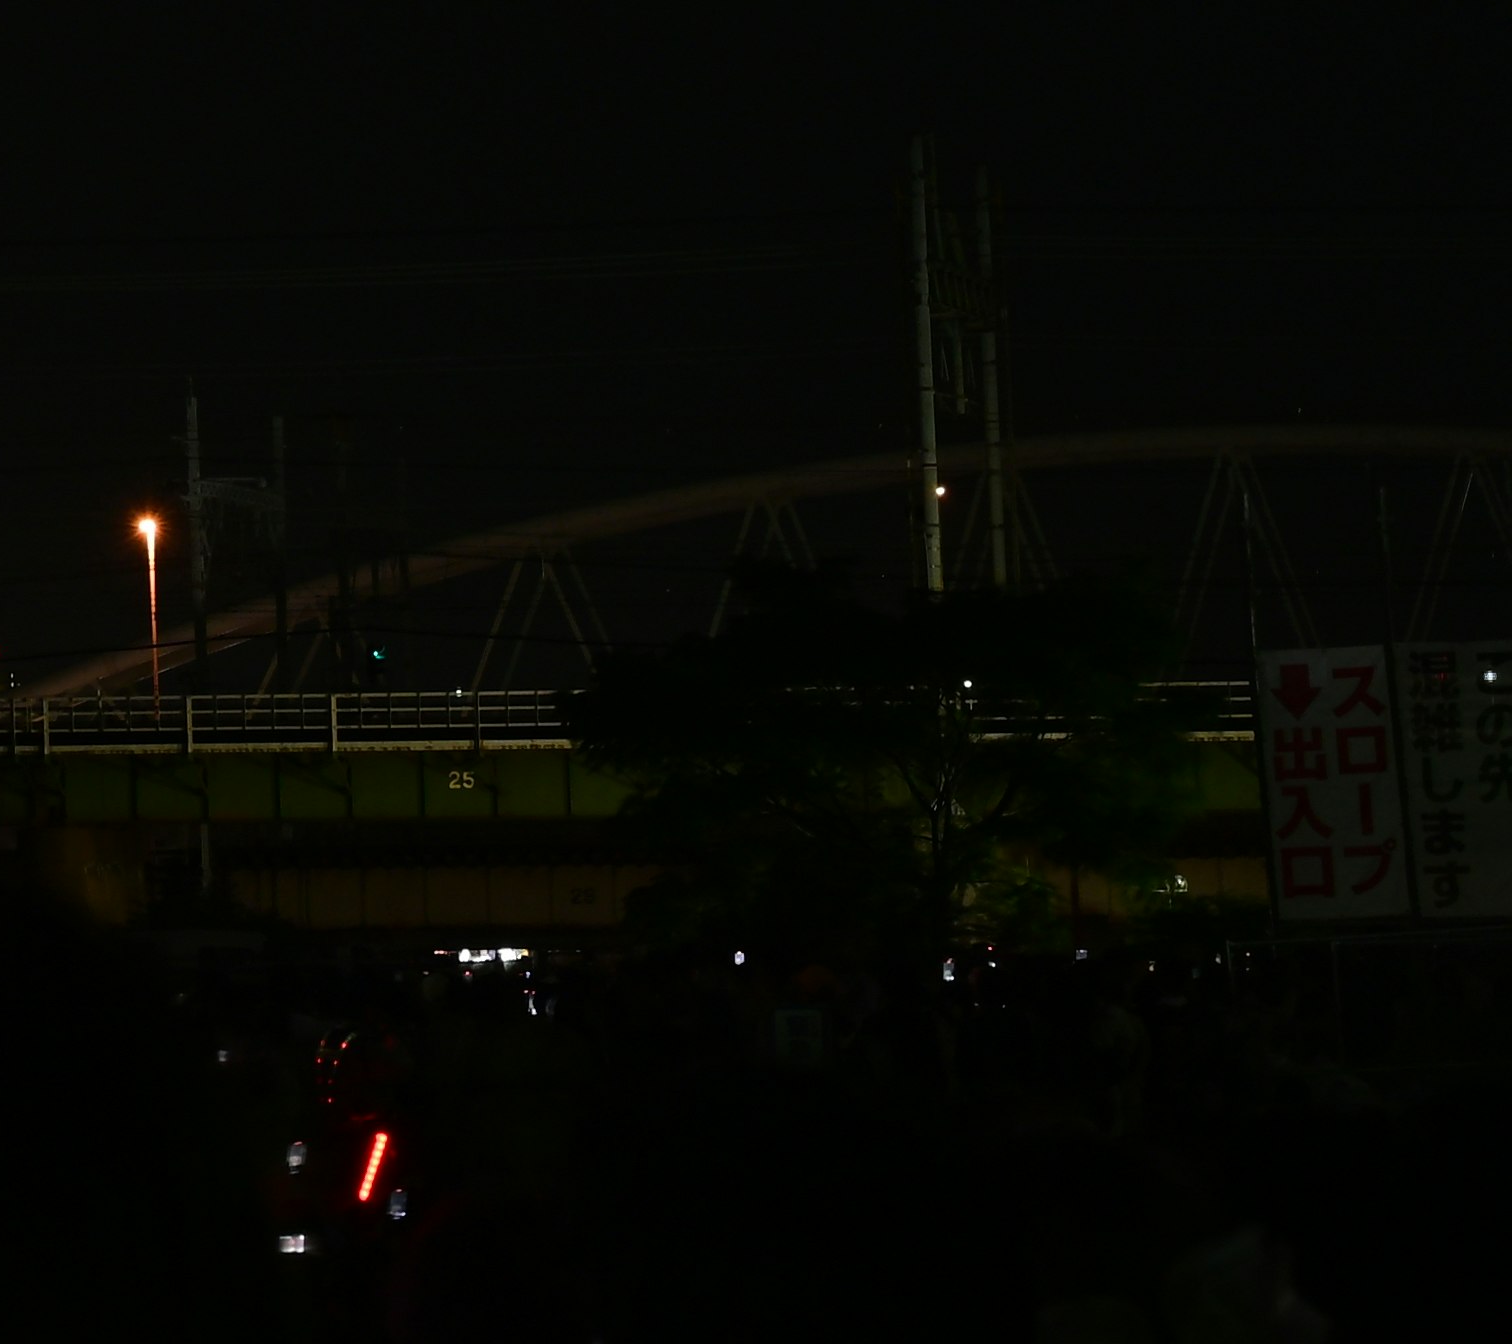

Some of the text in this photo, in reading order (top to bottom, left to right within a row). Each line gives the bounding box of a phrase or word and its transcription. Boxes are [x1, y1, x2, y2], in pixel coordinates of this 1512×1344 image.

[1274, 726, 1335, 898] 出入口
[1333, 666, 1397, 894] スロープ
